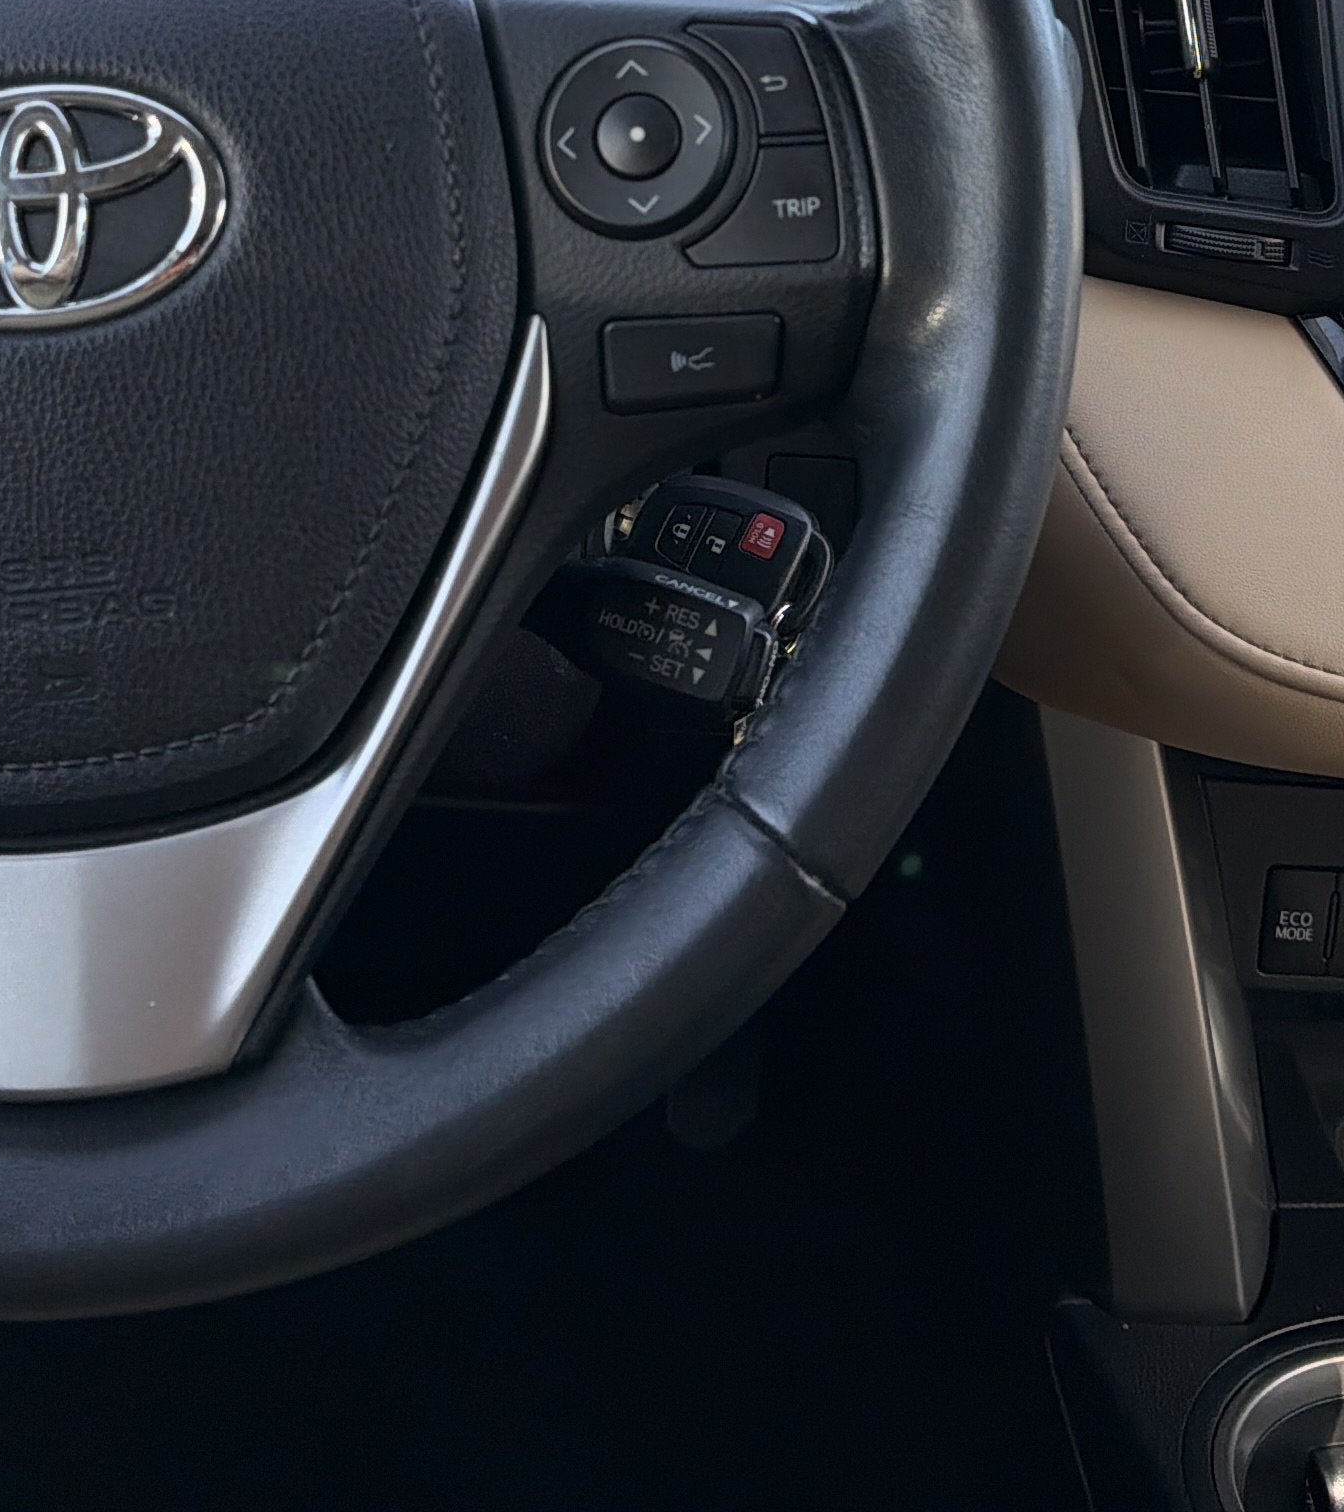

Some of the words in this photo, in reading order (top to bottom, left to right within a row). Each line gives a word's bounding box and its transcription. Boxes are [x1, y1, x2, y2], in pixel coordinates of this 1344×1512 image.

[772, 198, 821, 219] TRIP
[747, 521, 765, 545] HOLD
[655, 574, 723, 607] CANCEL
[599, 609, 639, 635] HOLD
[664, 603, 701, 630] RES
[648, 655, 686, 680] SET
[1279, 910, 1313, 927] ECO
[1275, 926, 1313, 941] MODE
